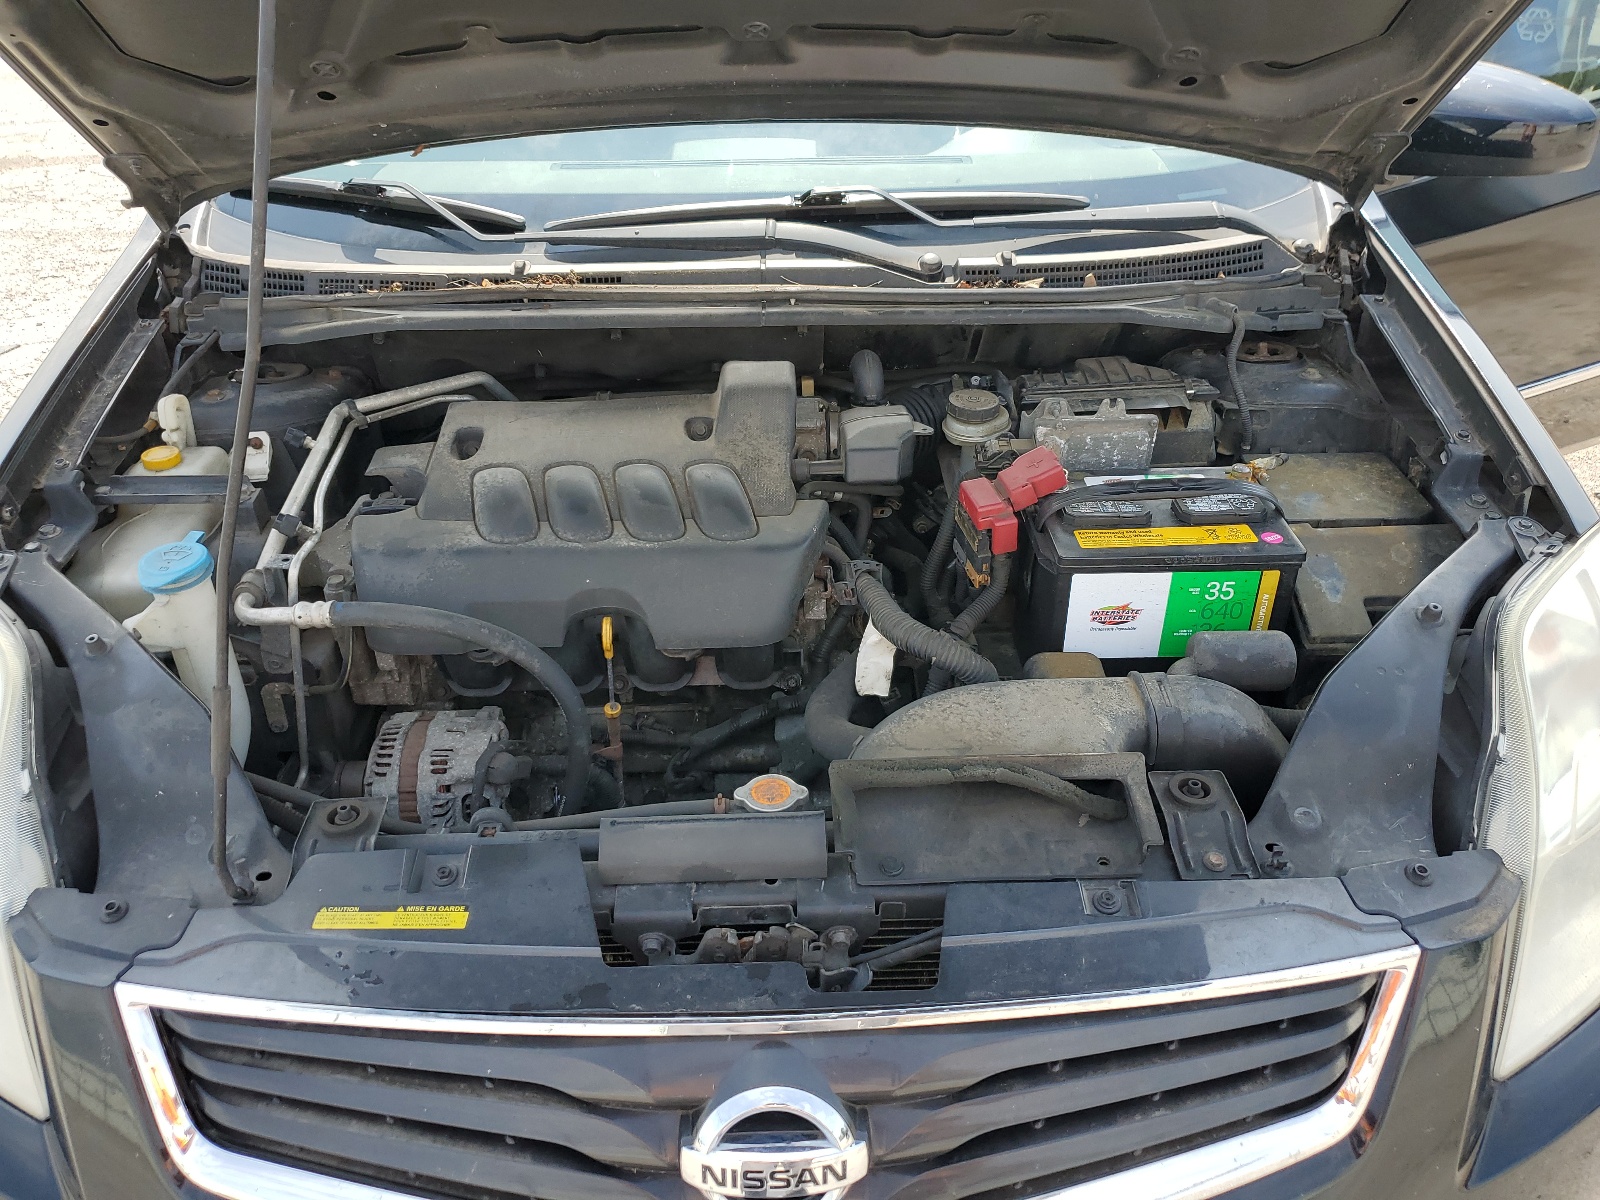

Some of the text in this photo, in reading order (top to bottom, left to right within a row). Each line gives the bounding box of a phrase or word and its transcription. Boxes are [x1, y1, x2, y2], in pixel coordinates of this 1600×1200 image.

[1204, 581, 1236, 600] 35
[1200, 601, 1244, 620] 640
[701, 1159, 848, 1190] NISSAN
